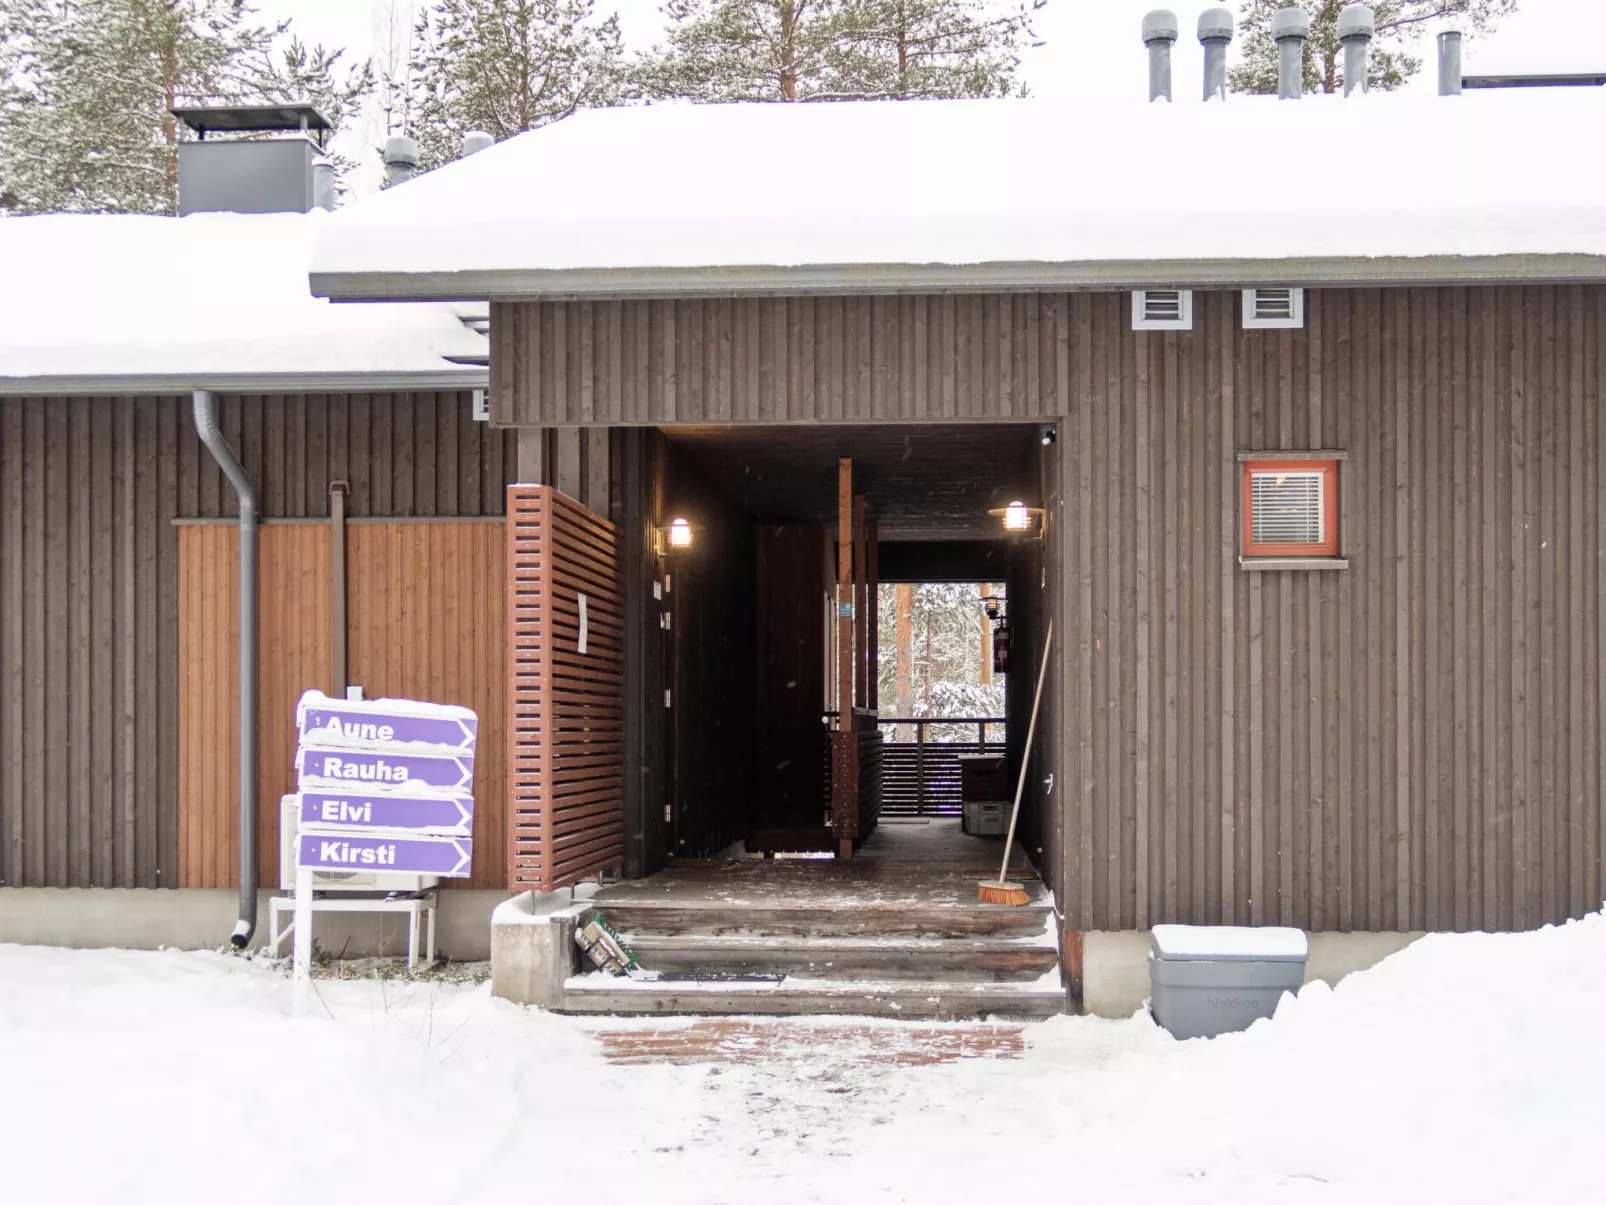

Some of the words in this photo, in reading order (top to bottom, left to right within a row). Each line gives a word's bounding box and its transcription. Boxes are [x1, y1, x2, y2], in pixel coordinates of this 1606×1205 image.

[326, 717, 394, 741] Aune
[324, 757, 408, 781] Rauha
[321, 800, 372, 822] Elvi
[320, 841, 396, 865] Kirsti
